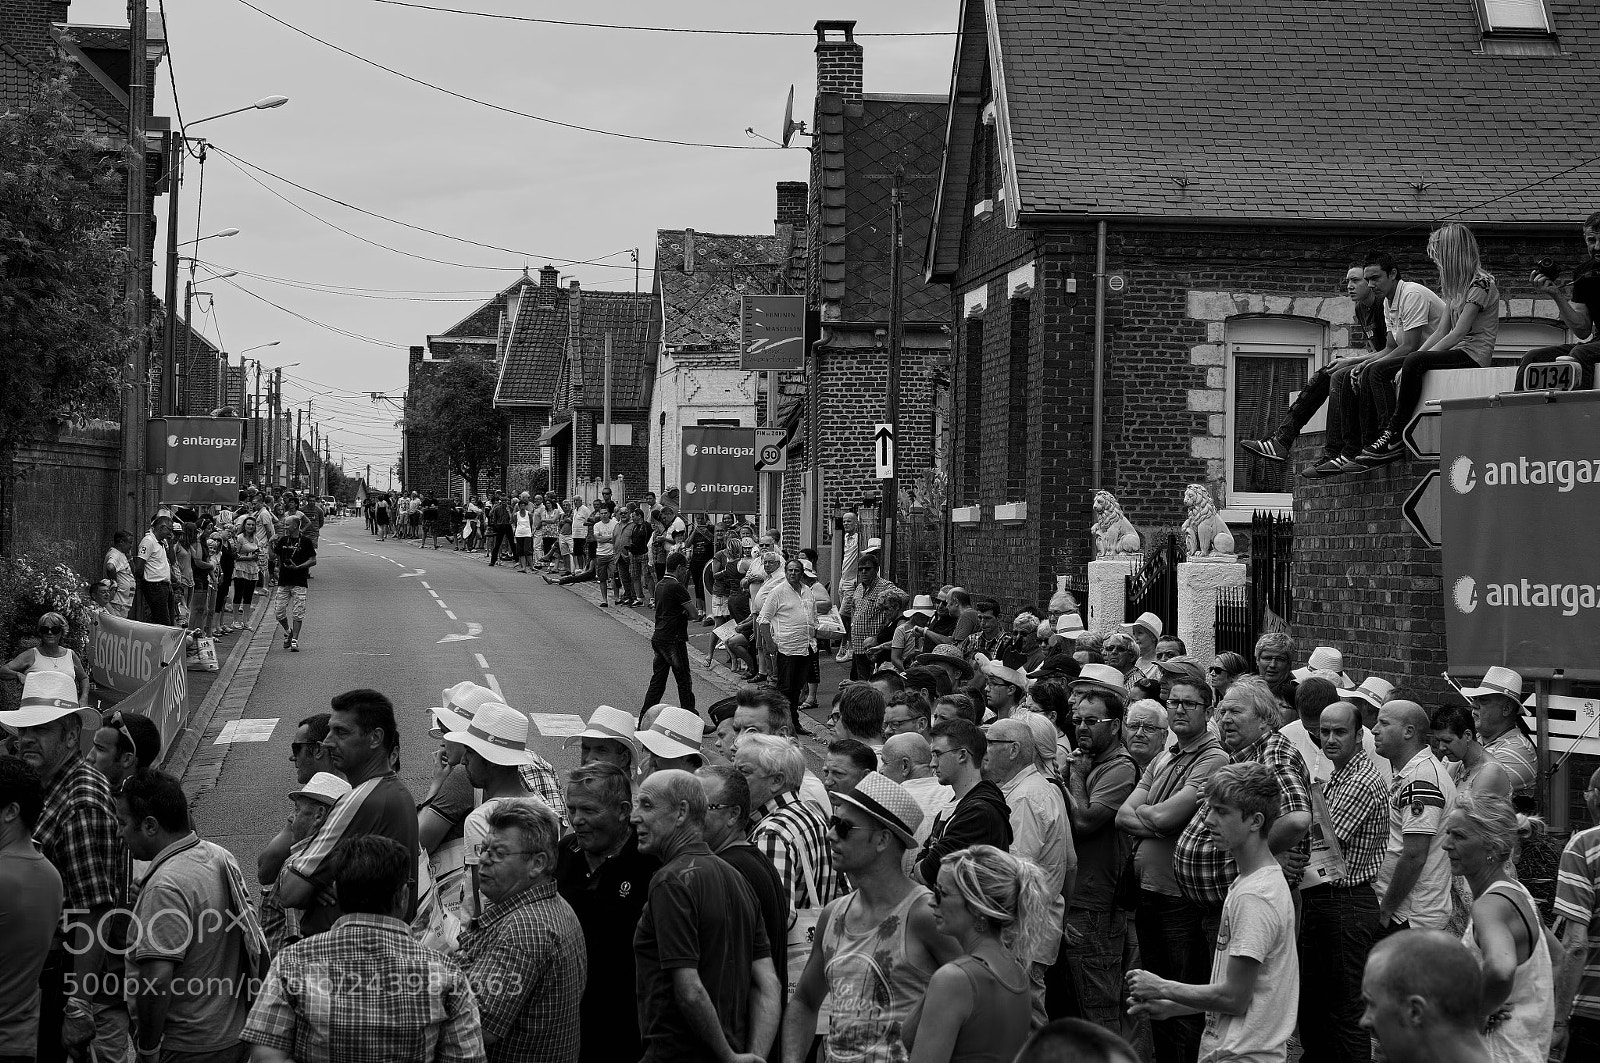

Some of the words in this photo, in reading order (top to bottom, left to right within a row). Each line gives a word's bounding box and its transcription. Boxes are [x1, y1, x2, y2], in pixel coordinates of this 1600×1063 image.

[1528, 366, 1570, 389] D134
[182, 435, 238, 449] antargaz
[701, 445, 754, 458] antargaz
[764, 451, 777, 460] 30
[182, 473, 237, 486] antargaz
[700, 483, 754, 495] antargaz
